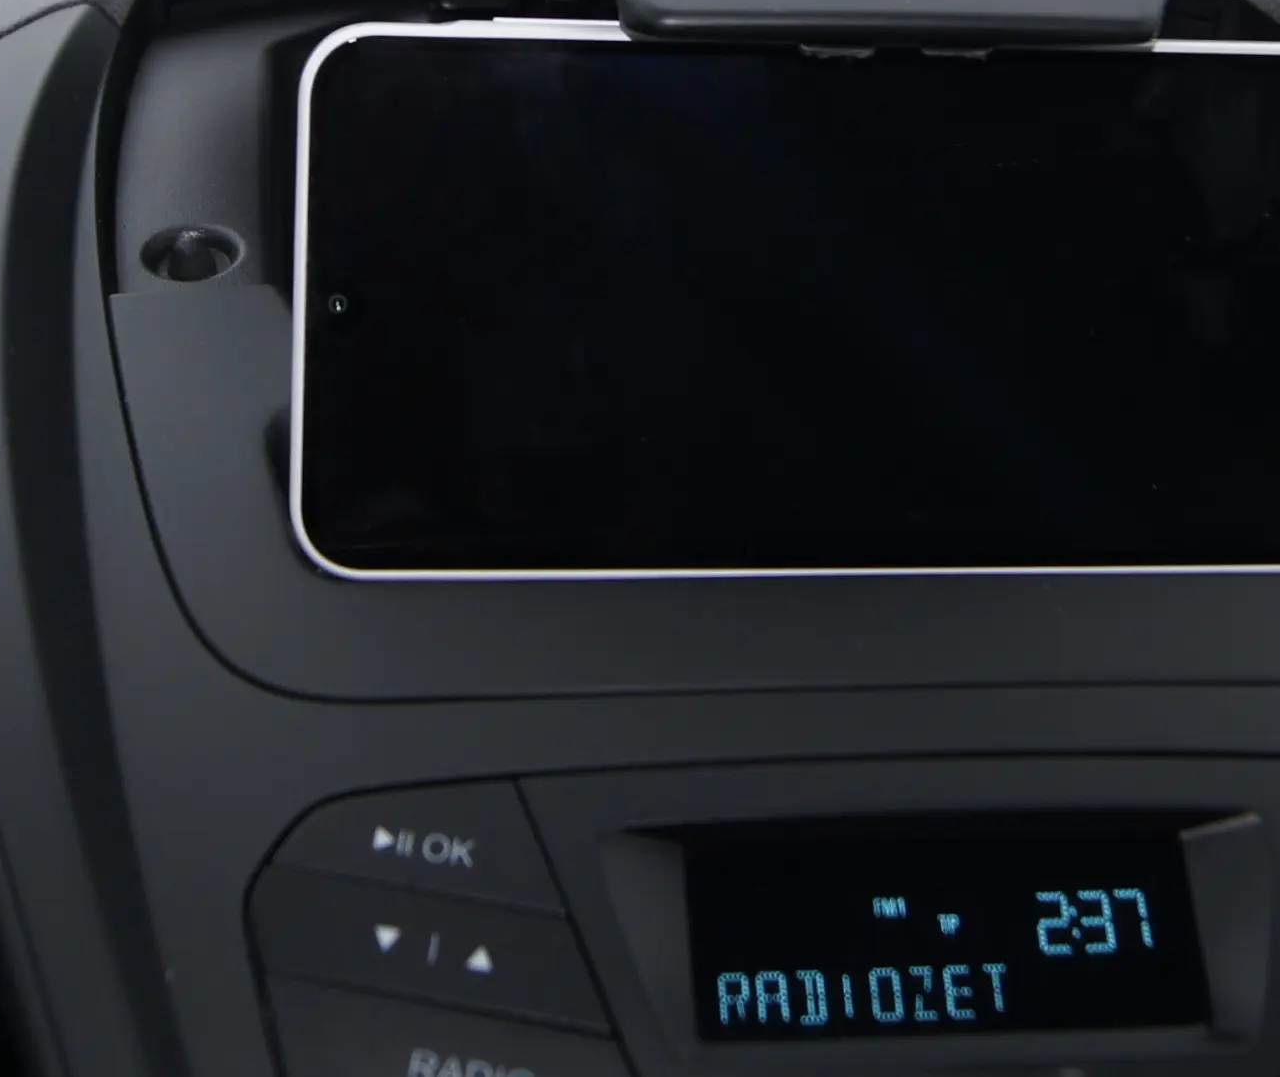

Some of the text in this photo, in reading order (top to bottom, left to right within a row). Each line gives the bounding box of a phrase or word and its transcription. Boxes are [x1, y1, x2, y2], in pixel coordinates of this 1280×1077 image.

[422, 832, 475, 868] OK
[1035, 888, 1153, 955] 2:37
[718, 962, 1007, 1025] RADIOZET
